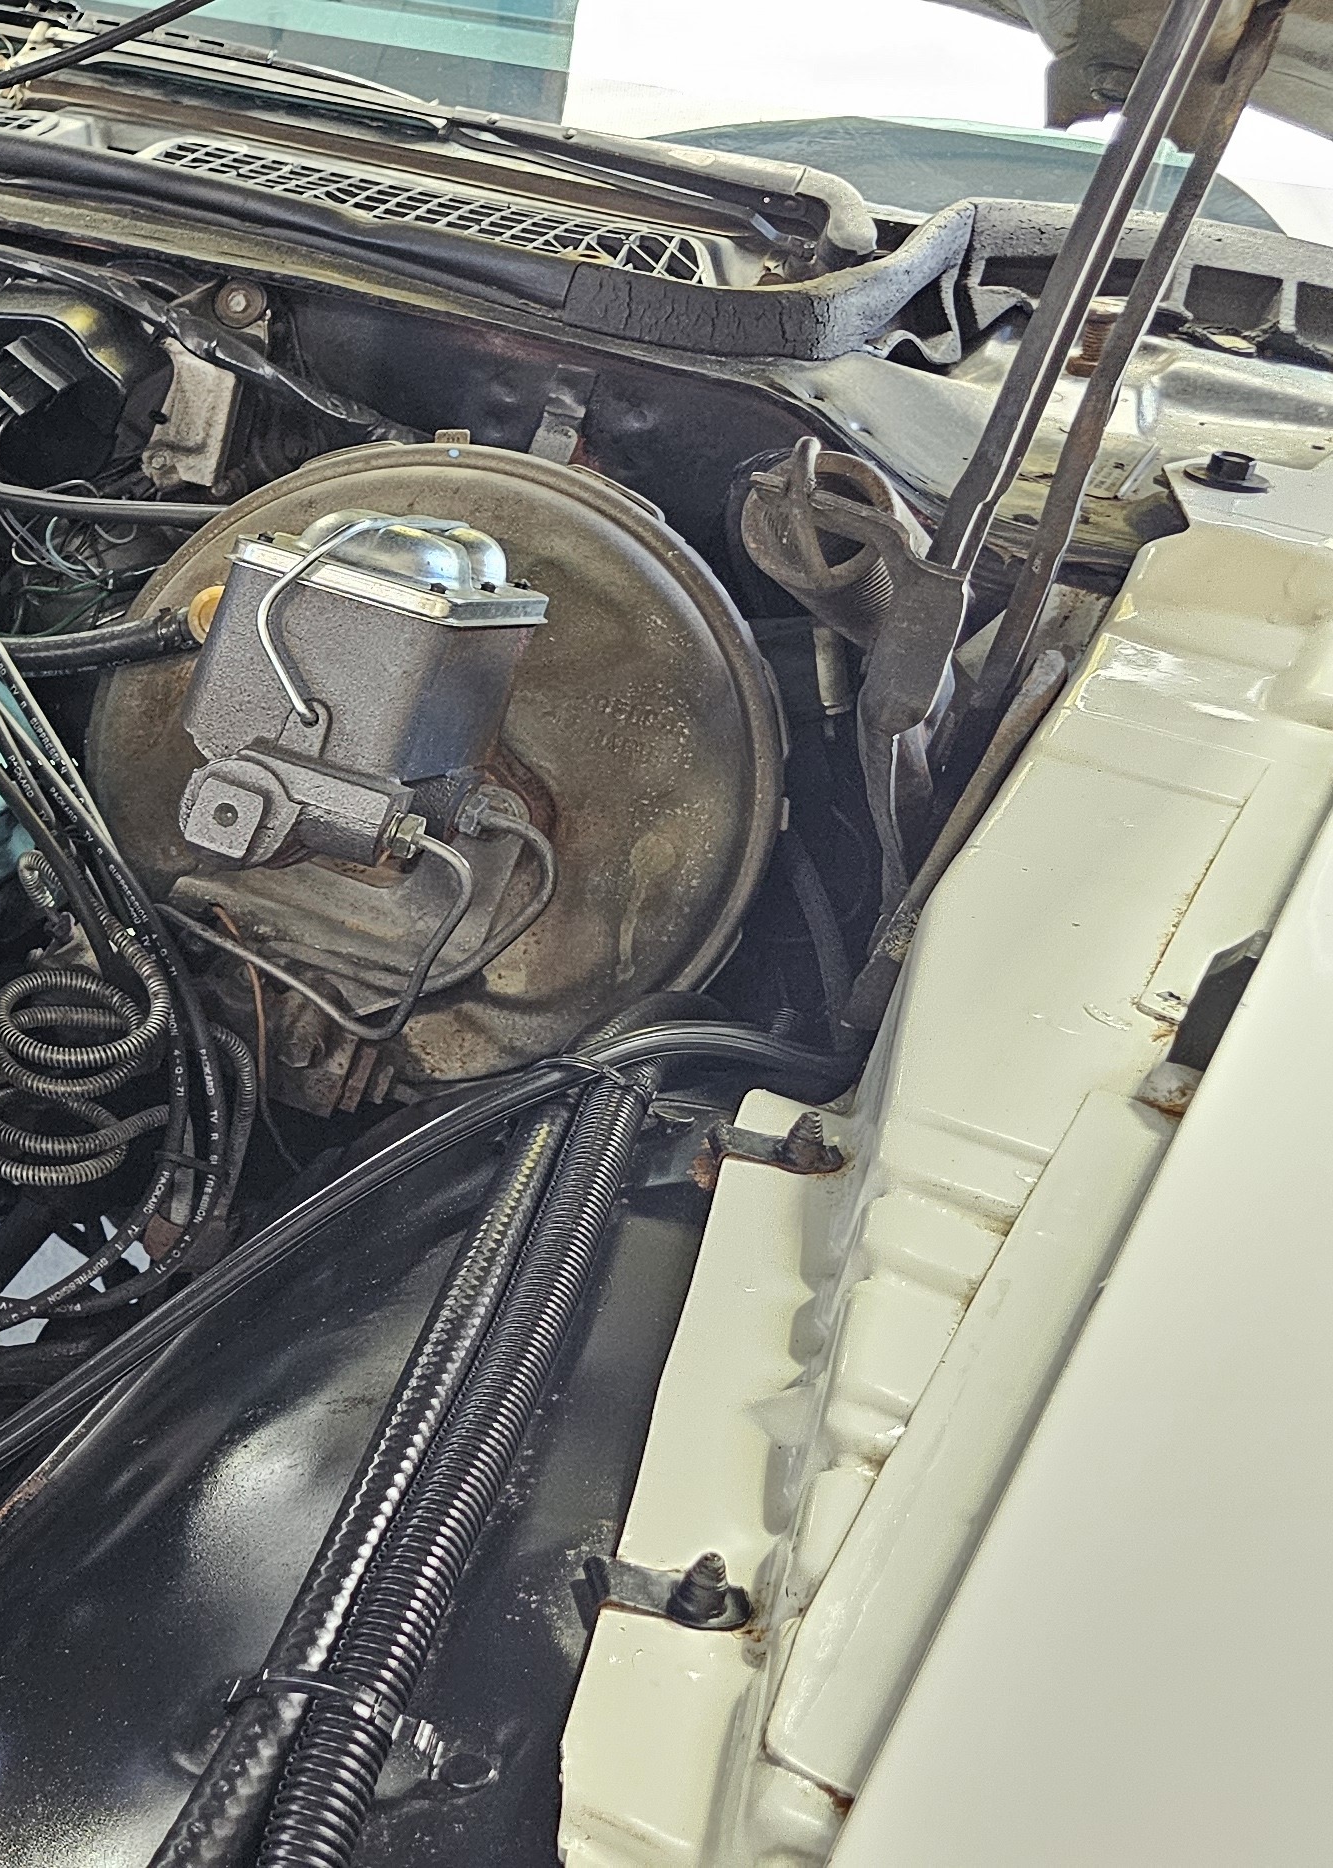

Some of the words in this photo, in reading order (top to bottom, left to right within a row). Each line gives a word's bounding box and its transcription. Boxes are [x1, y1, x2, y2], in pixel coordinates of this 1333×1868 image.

[9, 684, 20, 696] TV
[7, 754, 34, 799] PACKARD
[37, 809, 50, 823] TV
[48, 786, 79, 824] PACKARD
[83, 829, 94, 843] TV
[199, 1048, 216, 1097] PACKARD
[209, 1109, 219, 1124] TV
[210, 1132, 220, 1141] R
[142, 1170, 171, 1215] PACKARD
[126, 1224, 140, 1239] TV
[46, 1257, 109, 1305] SUPPRESSION
